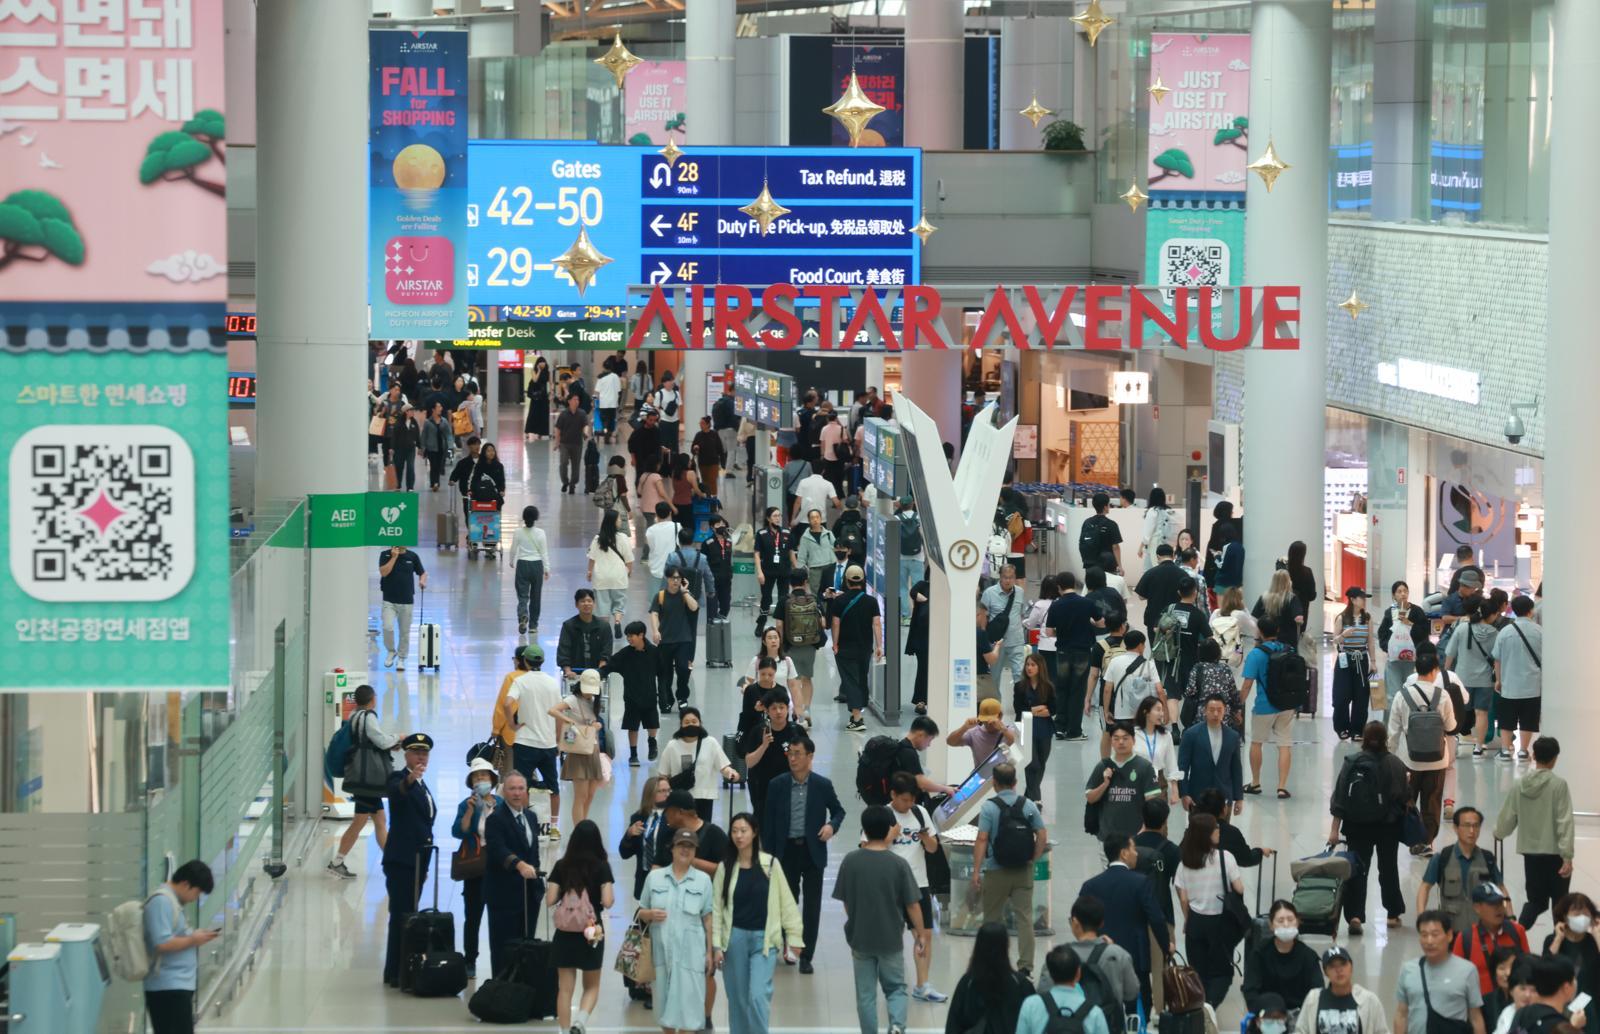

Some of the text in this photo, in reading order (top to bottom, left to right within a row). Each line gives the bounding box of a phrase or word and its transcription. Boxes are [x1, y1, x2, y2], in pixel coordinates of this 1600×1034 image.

[382, 66, 455, 96] FALL
[1178, 70, 1222, 88] JUST
[643, 84, 668, 95] JUST
[410, 98, 428, 109] for
[640, 96, 672, 108] USE IT
[1173, 92, 1227, 108] USE IT
[383, 110, 455, 126] SHOPPING
[634, 109, 678, 121] AIRSTAR
[1164, 111, 1234, 129] AIRSTAR
[551, 160, 601, 179] Gates
[678, 162, 699, 182] 28
[799, 168, 906, 186] Tax Refund, 退税
[677, 186, 692, 194] 90m
[487, 186, 603, 226] 42-50
[396, 215, 421, 223] Golden
[677, 212, 699, 232] 4F
[717, 219, 747, 238] Duty
[778, 219, 828, 238] Pick-up,
[830, 219, 905, 235] 免税品领取处
[677, 262, 698, 281] 4F
[790, 267, 905, 285] Food Court, 美食街
[396, 280, 443, 290] AIRSTAR
[513, 305, 552, 318] 42-50
[626, 282, 1300, 351] AIRSTAR AVENUE
[506, 327, 536, 338] Desk
[577, 329, 623, 341] Transfer
[16, 383, 100, 408] 스마트한
[331, 509, 356, 521] AED
[378, 526, 403, 536] AED
